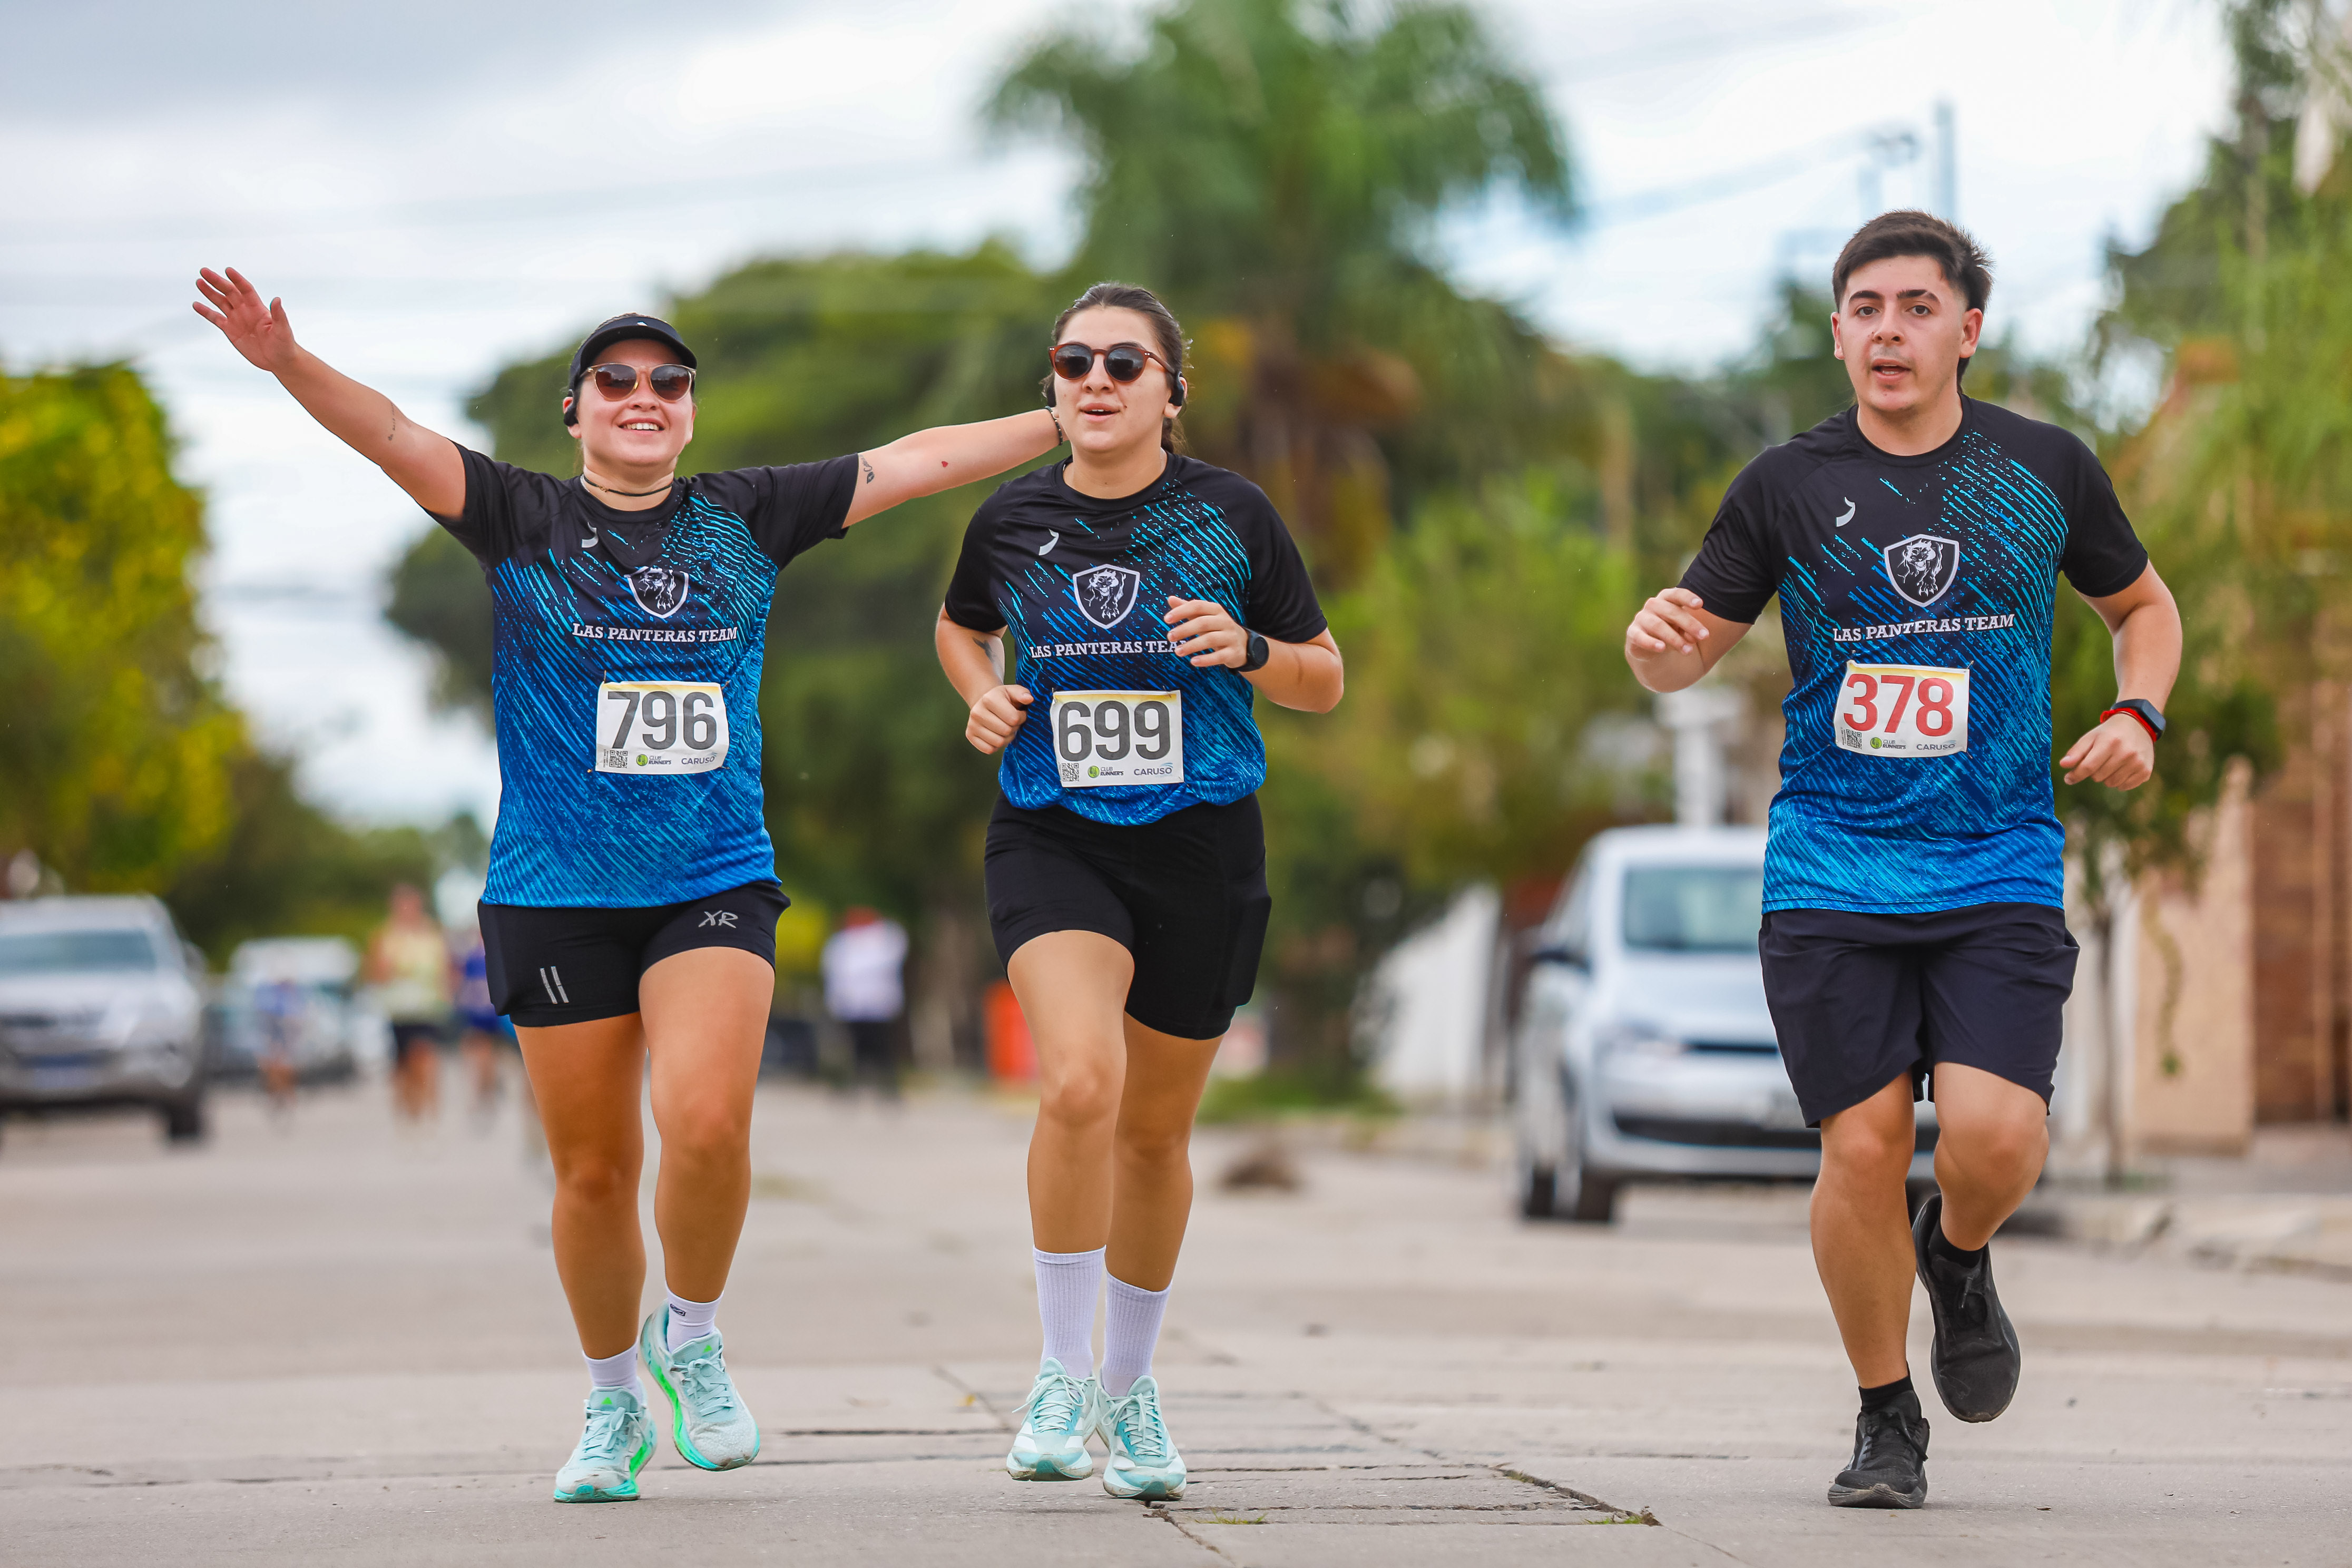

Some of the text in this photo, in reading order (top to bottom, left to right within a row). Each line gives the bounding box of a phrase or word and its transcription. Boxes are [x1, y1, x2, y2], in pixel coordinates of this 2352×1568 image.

[572, 623, 738, 642] LAS PANTERAS TEAM
[1832, 614, 2015, 642] LAS PANTERAS TEAM
[1029, 640, 1187, 659] LAS PANTERAS TEA
[1844, 673, 1954, 737] 378
[607, 691, 717, 750] 796
[1059, 700, 1171, 762] 699
[681, 756, 716, 765] CARUSO
[698, 910, 739, 928] XR
